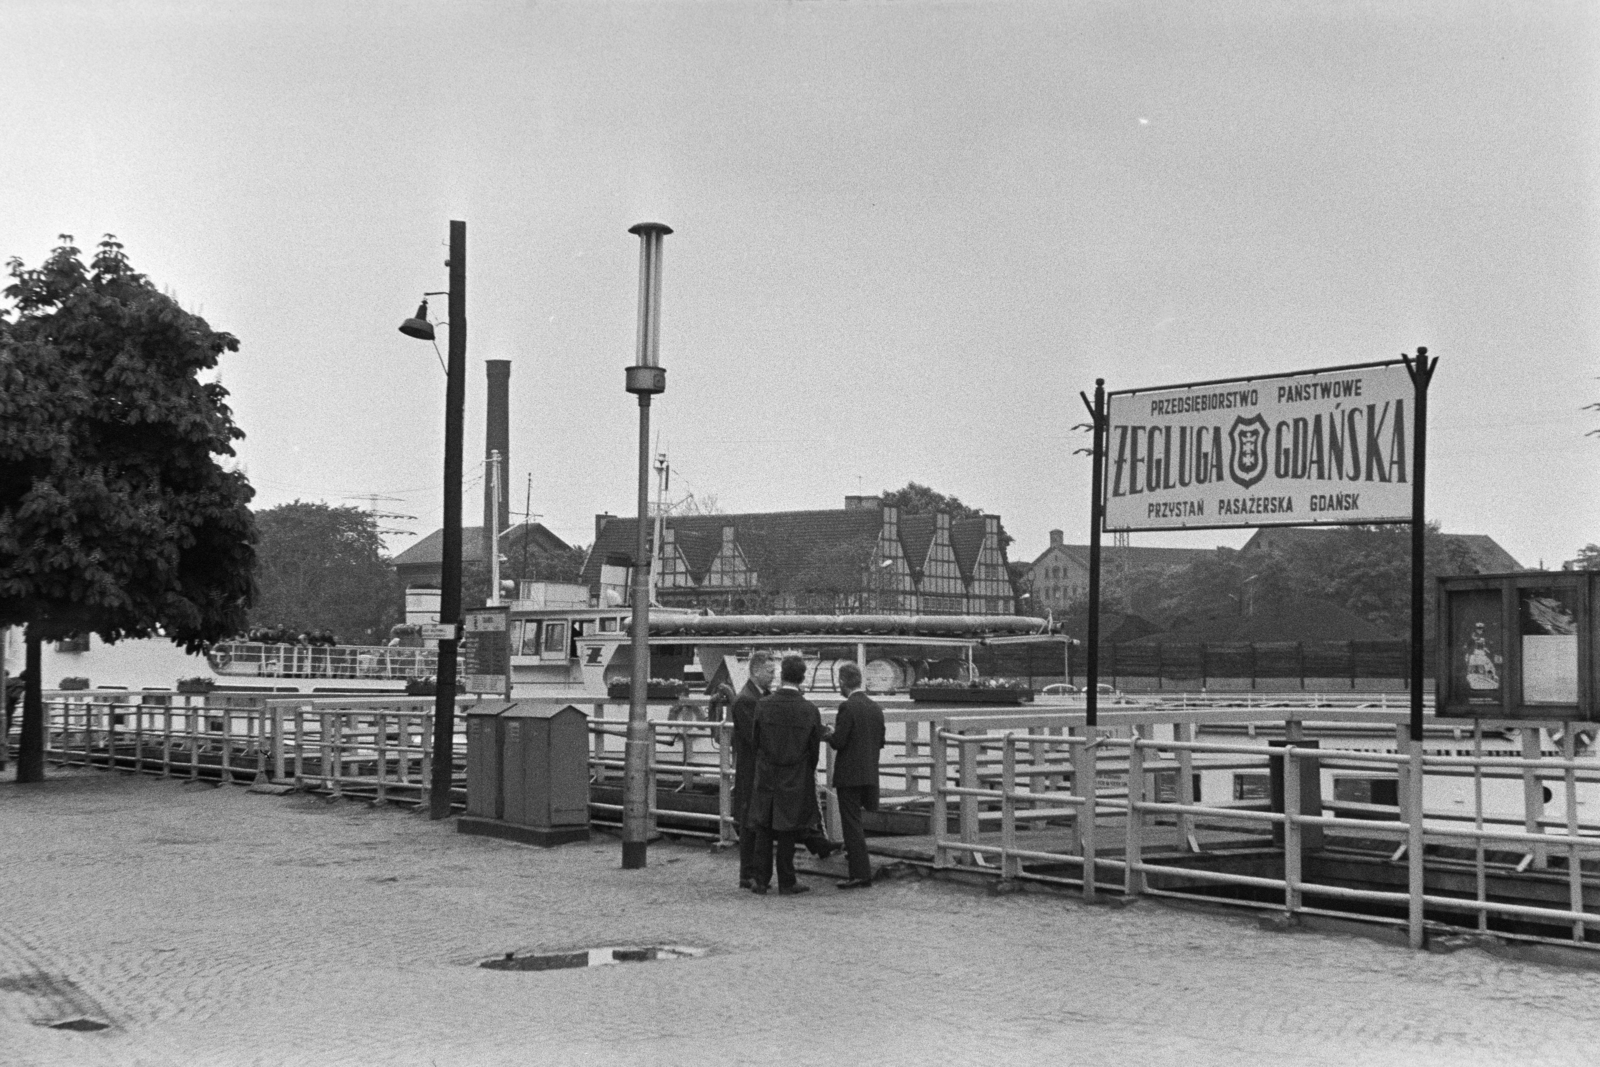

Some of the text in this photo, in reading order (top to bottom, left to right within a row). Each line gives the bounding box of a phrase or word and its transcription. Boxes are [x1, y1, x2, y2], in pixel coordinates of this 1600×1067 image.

[1274, 398, 1408, 483] GDAŃSKA
[1218, 494, 1293, 515] PASAŻERSKA
[1310, 491, 1360, 512] GDAŃSK
